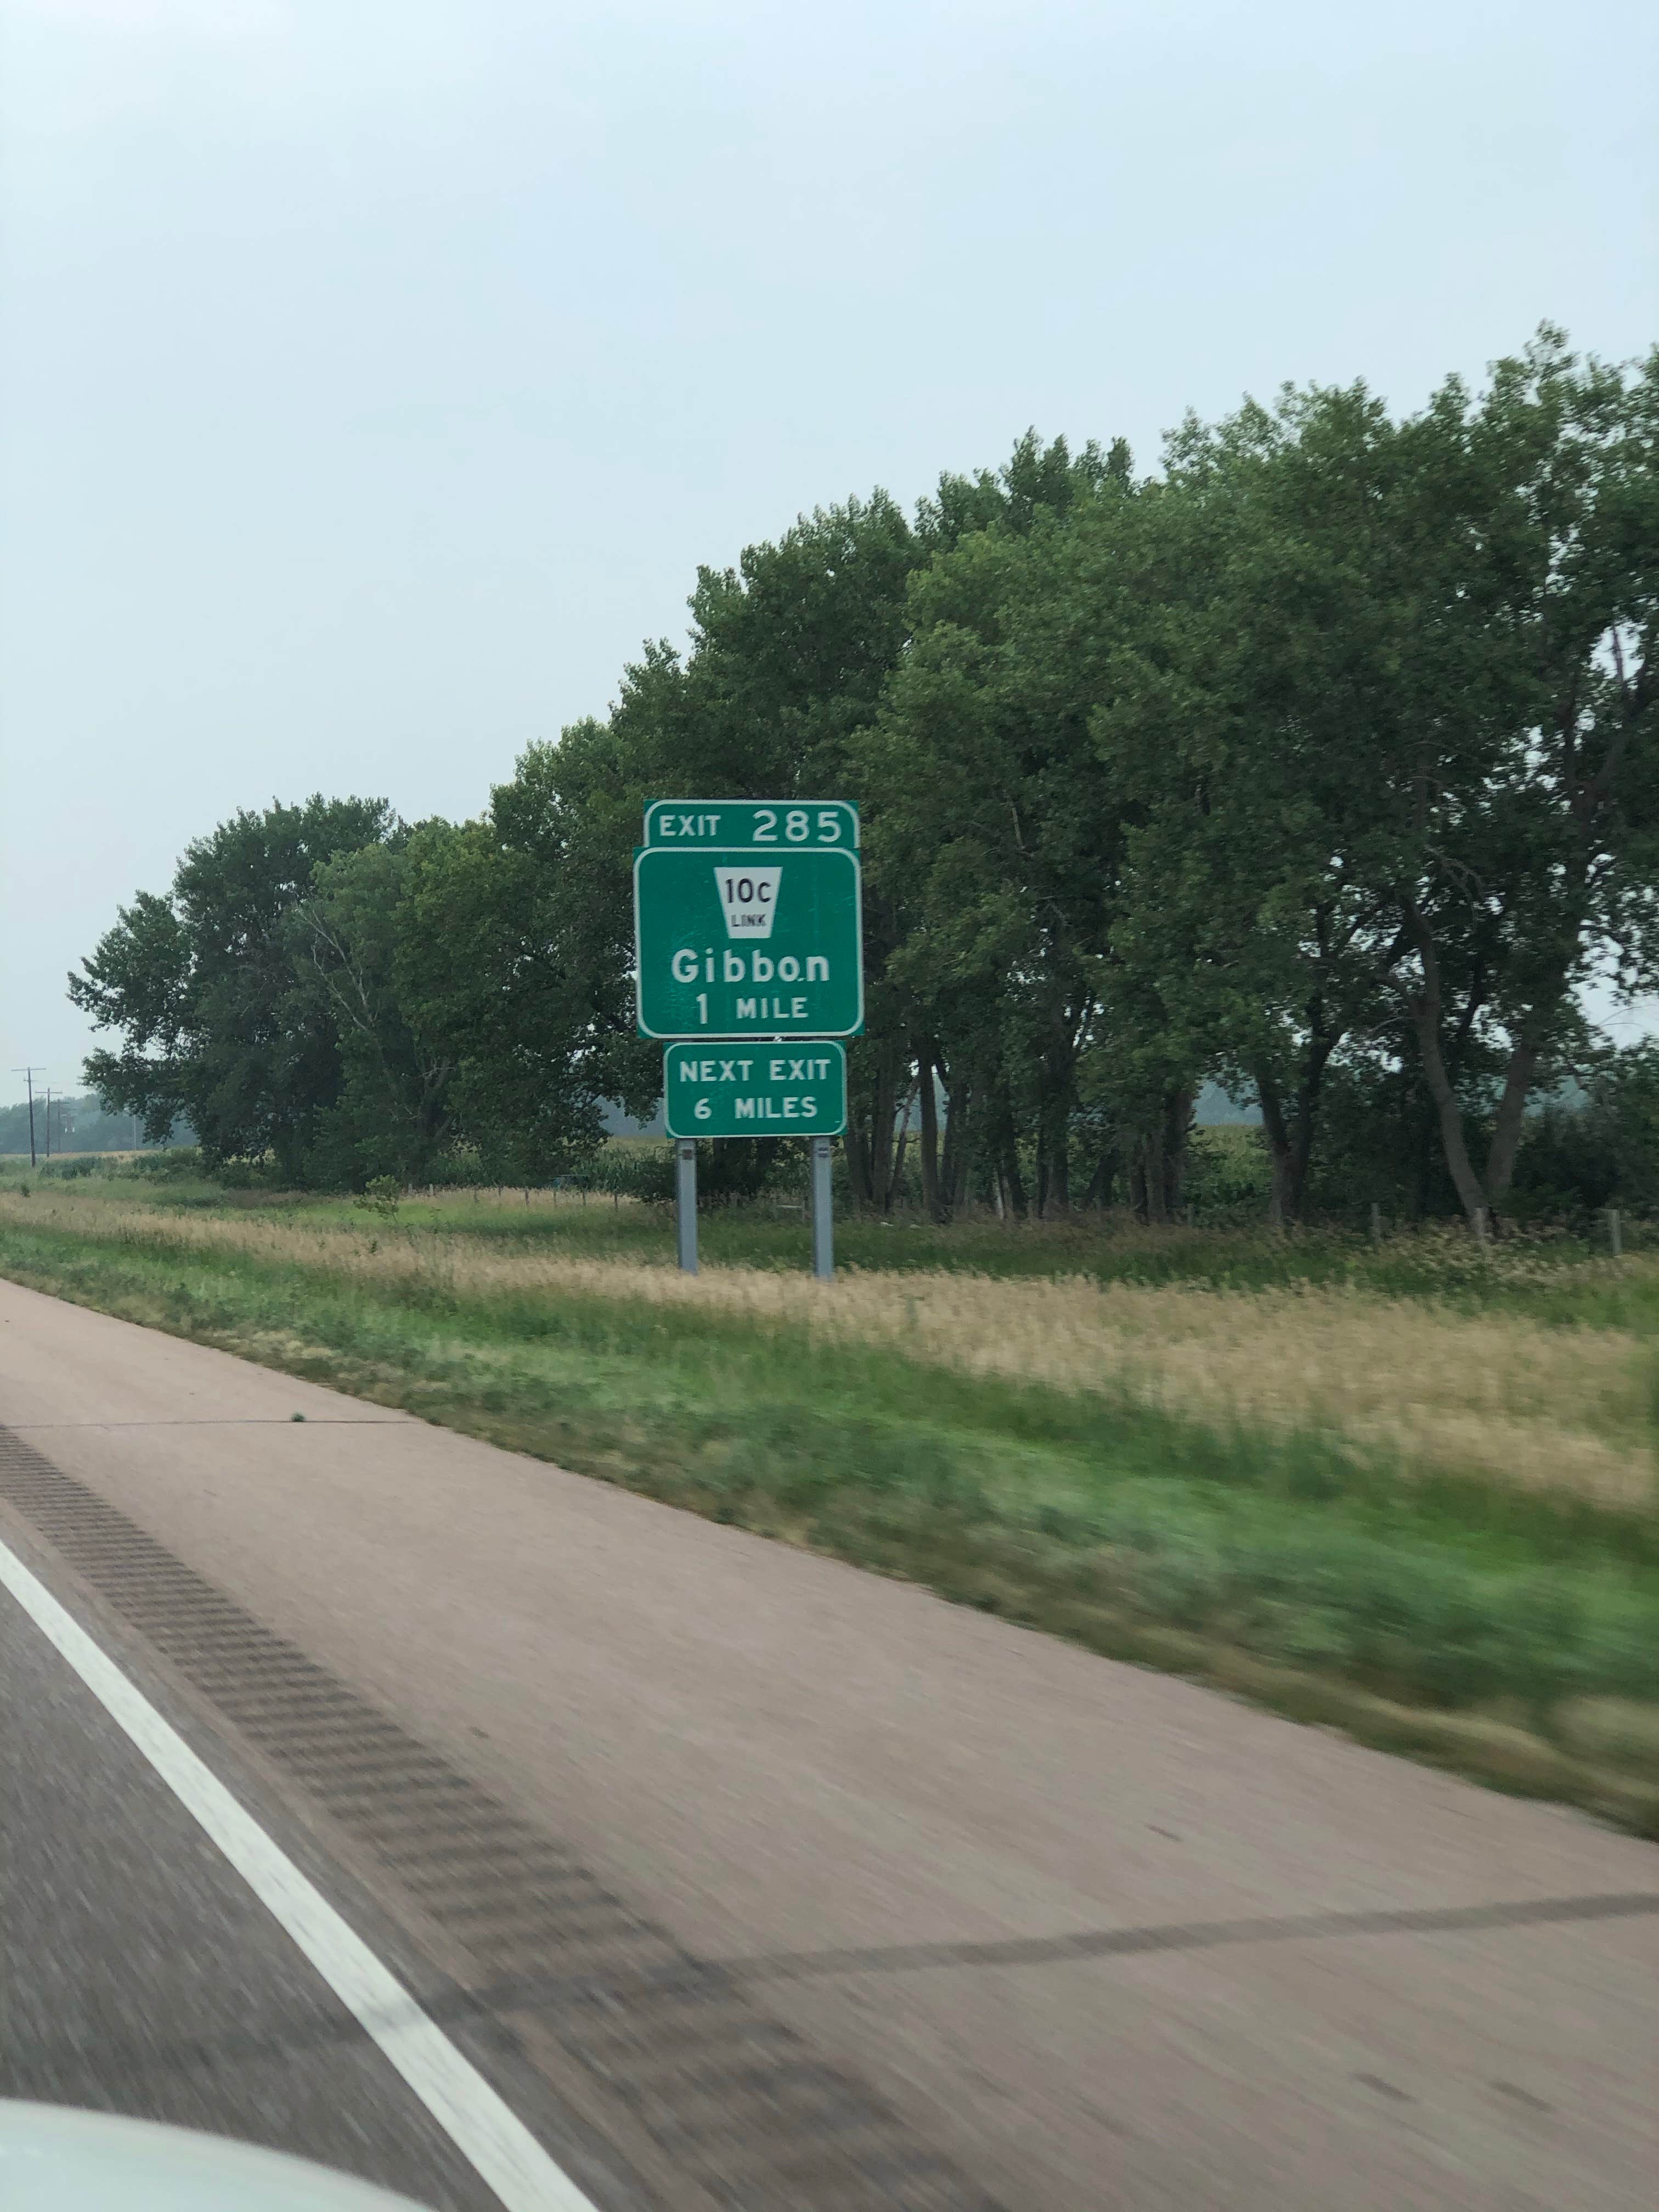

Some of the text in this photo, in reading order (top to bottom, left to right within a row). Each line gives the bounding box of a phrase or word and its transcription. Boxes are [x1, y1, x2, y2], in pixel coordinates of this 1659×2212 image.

[659, 809, 842, 842] EXIT 285
[731, 914, 766, 927] LINK
[672, 948, 829, 983] Gibbon
[697, 992, 808, 1024] 1 MILE
[680, 1059, 831, 1082] NEXT EXIT
[695, 1097, 817, 1120] 6 MILES
